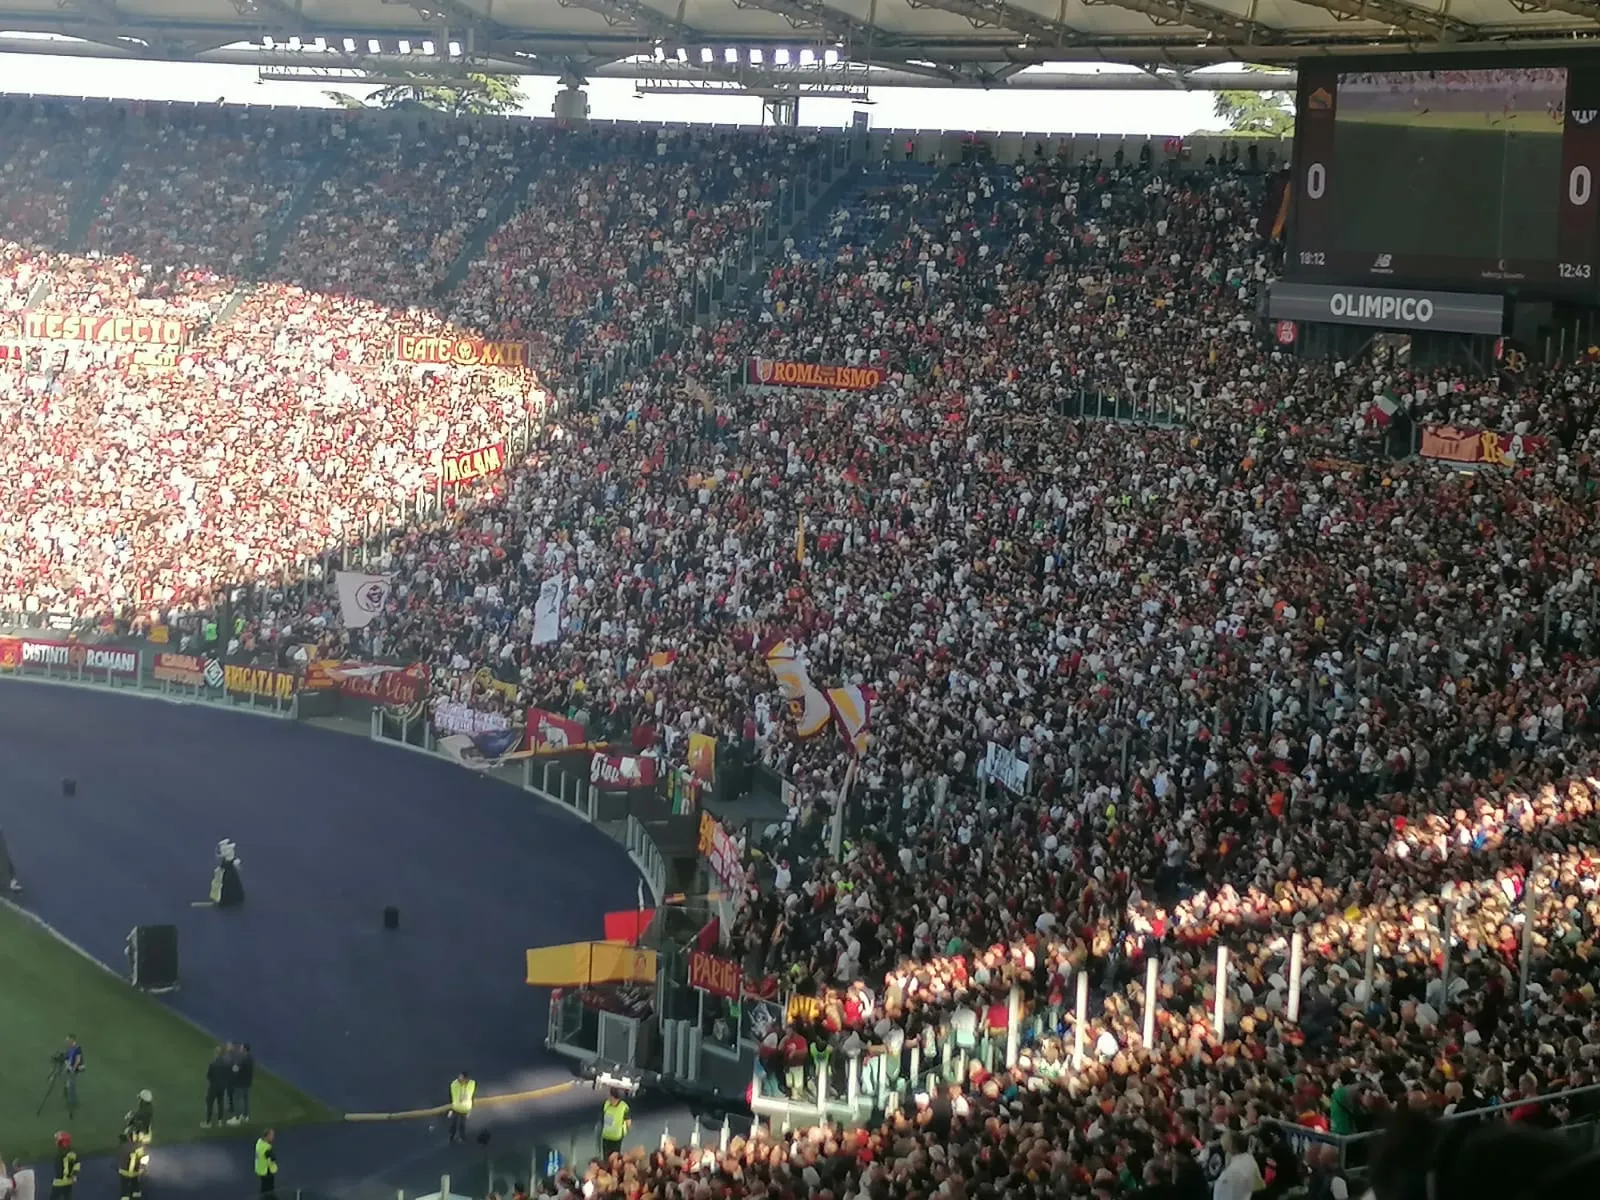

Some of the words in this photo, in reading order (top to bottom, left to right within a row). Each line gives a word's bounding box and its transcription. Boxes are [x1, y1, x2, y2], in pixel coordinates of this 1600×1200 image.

[1307, 162, 1326, 199] 0
[1569, 165, 1592, 205] 0
[1558, 262, 1591, 278] 12:43
[1330, 292, 1434, 322] OLIMPICO
[28, 313, 182, 344] TESTACCIO
[402, 336, 451, 362] GATE
[480, 342, 523, 366] XXII
[22, 641, 69, 665] DISTINTI
[86, 648, 136, 673] ROMANI
[692, 952, 738, 994] PARIGI
